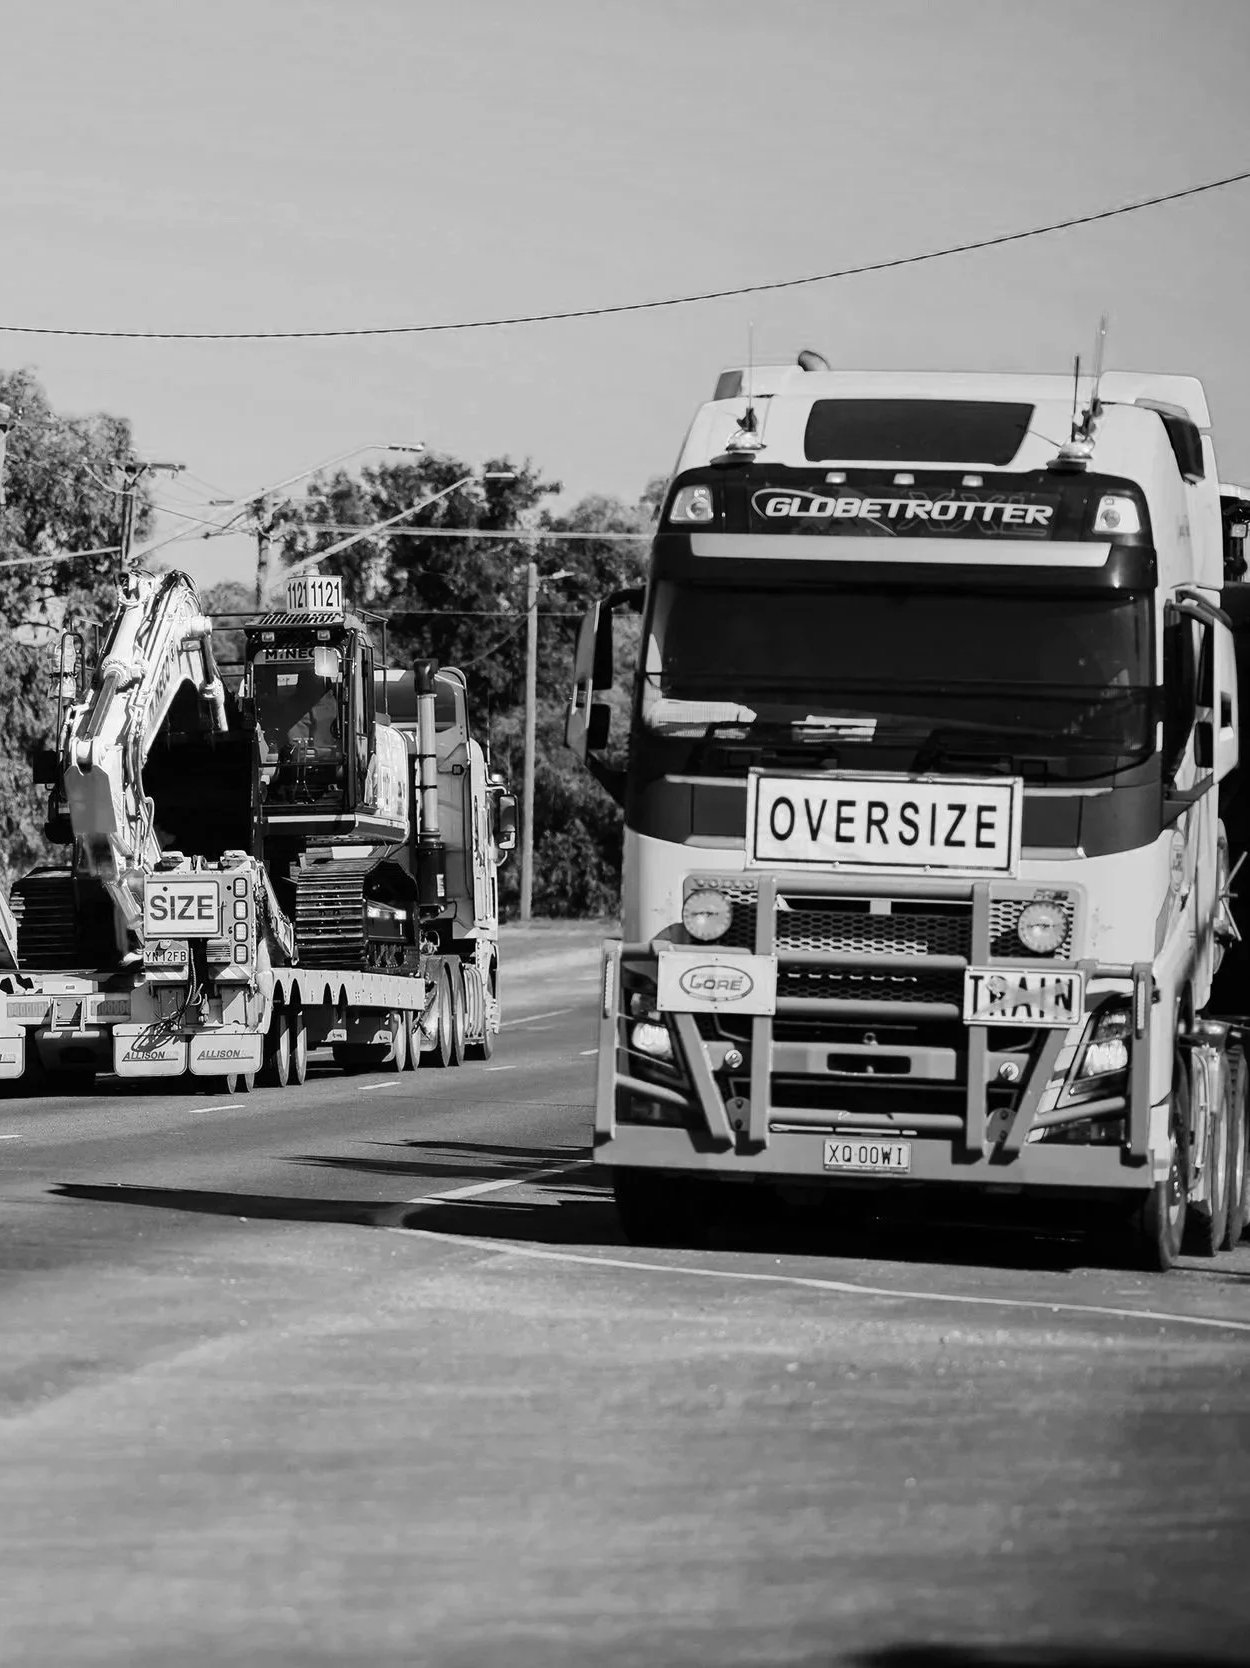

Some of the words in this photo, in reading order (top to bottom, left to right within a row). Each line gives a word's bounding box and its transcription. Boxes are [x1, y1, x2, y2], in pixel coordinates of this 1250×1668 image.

[765, 497, 1053, 526] GLOBETROTTER
[287, 581, 308, 609] 1121
[311, 581, 340, 608] 1121
[769, 796, 998, 849] OVERSIZE
[150, 895, 214, 921] SIZE
[690, 974, 743, 991] GORE
[123, 1050, 166, 1060] ALLISON
[198, 1049, 241, 1059] ALLISON
